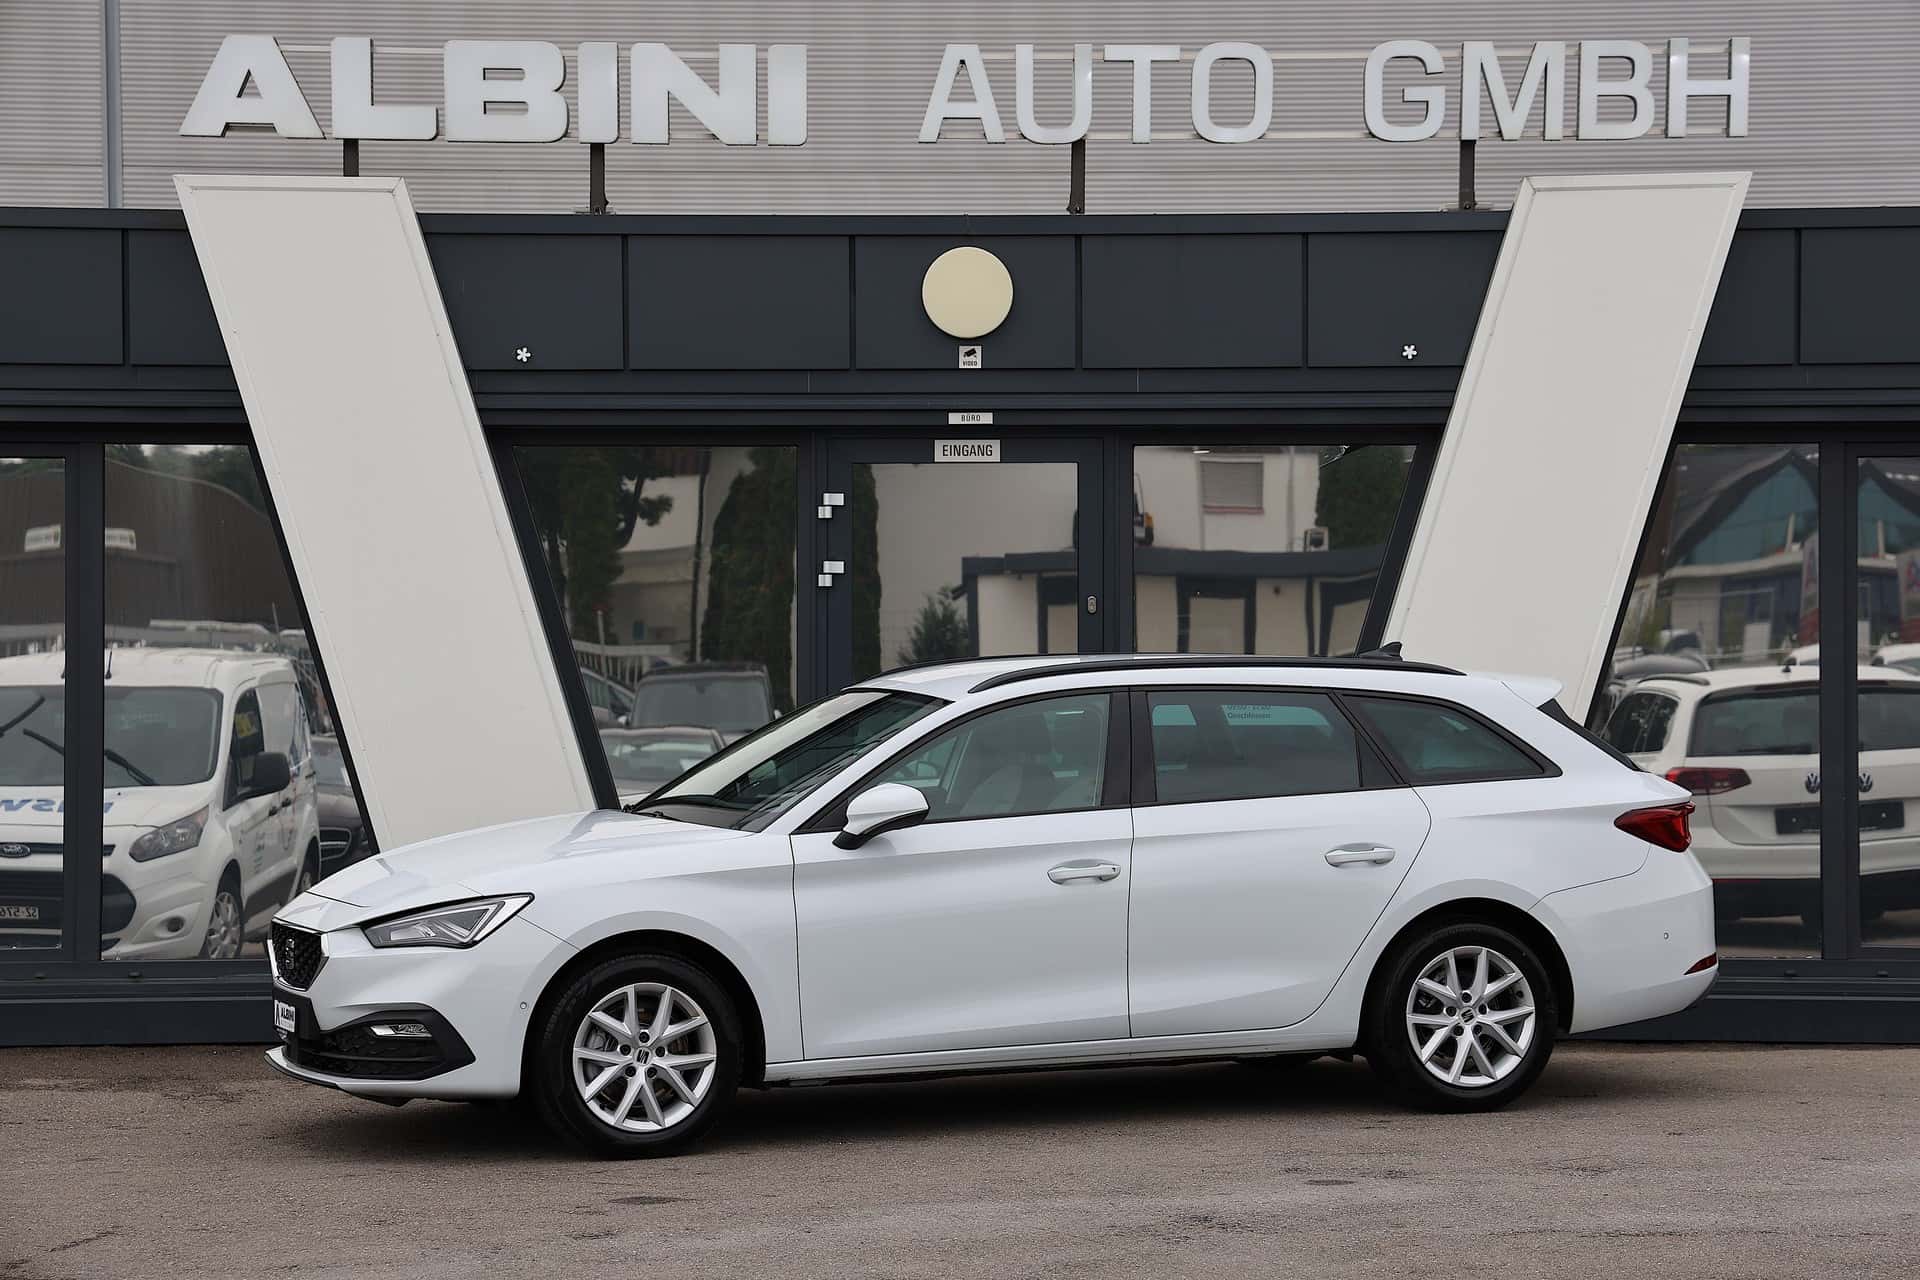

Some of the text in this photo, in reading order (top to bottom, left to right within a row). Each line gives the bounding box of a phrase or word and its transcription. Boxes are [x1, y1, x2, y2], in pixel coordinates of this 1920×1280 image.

[180, 34, 1752, 146] ALBINI AUTO GMBH
[942, 443, 993, 457] EINGANG
